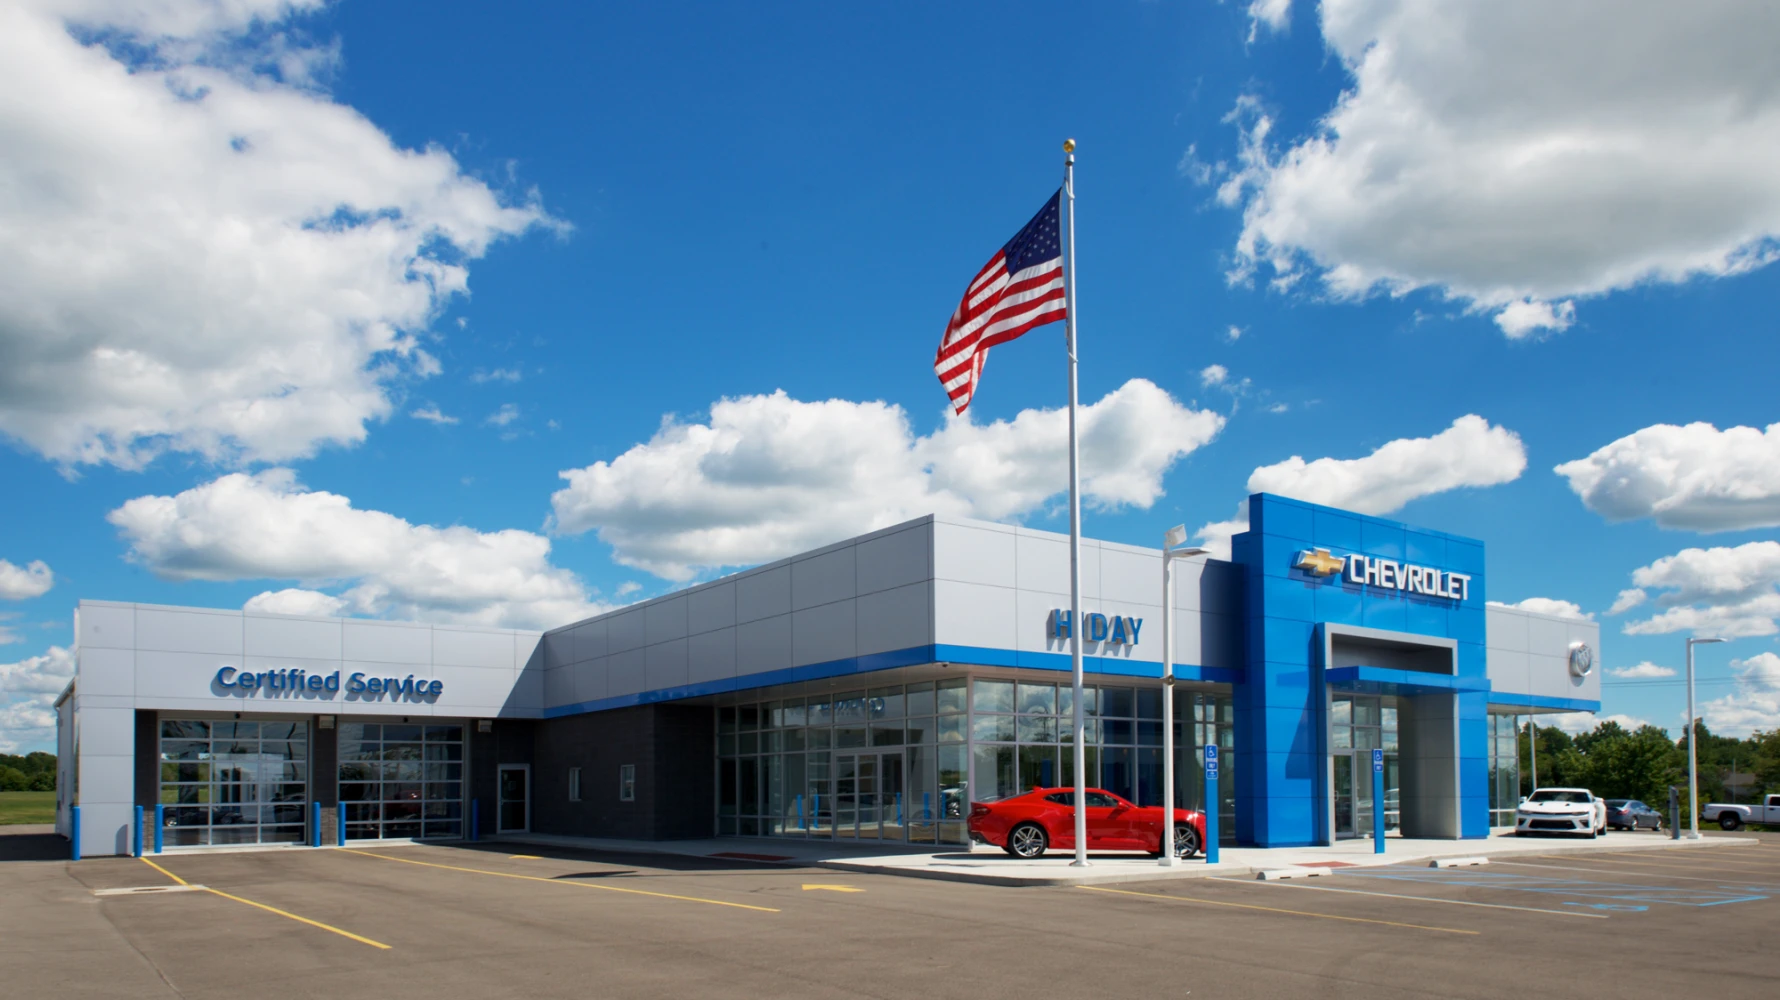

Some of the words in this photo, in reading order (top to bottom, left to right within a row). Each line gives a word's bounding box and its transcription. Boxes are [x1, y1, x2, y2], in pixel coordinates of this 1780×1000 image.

[1349, 553, 1471, 600] CHEVROLET
[216, 666, 340, 692] Certified
[350, 672, 443, 695] Service
